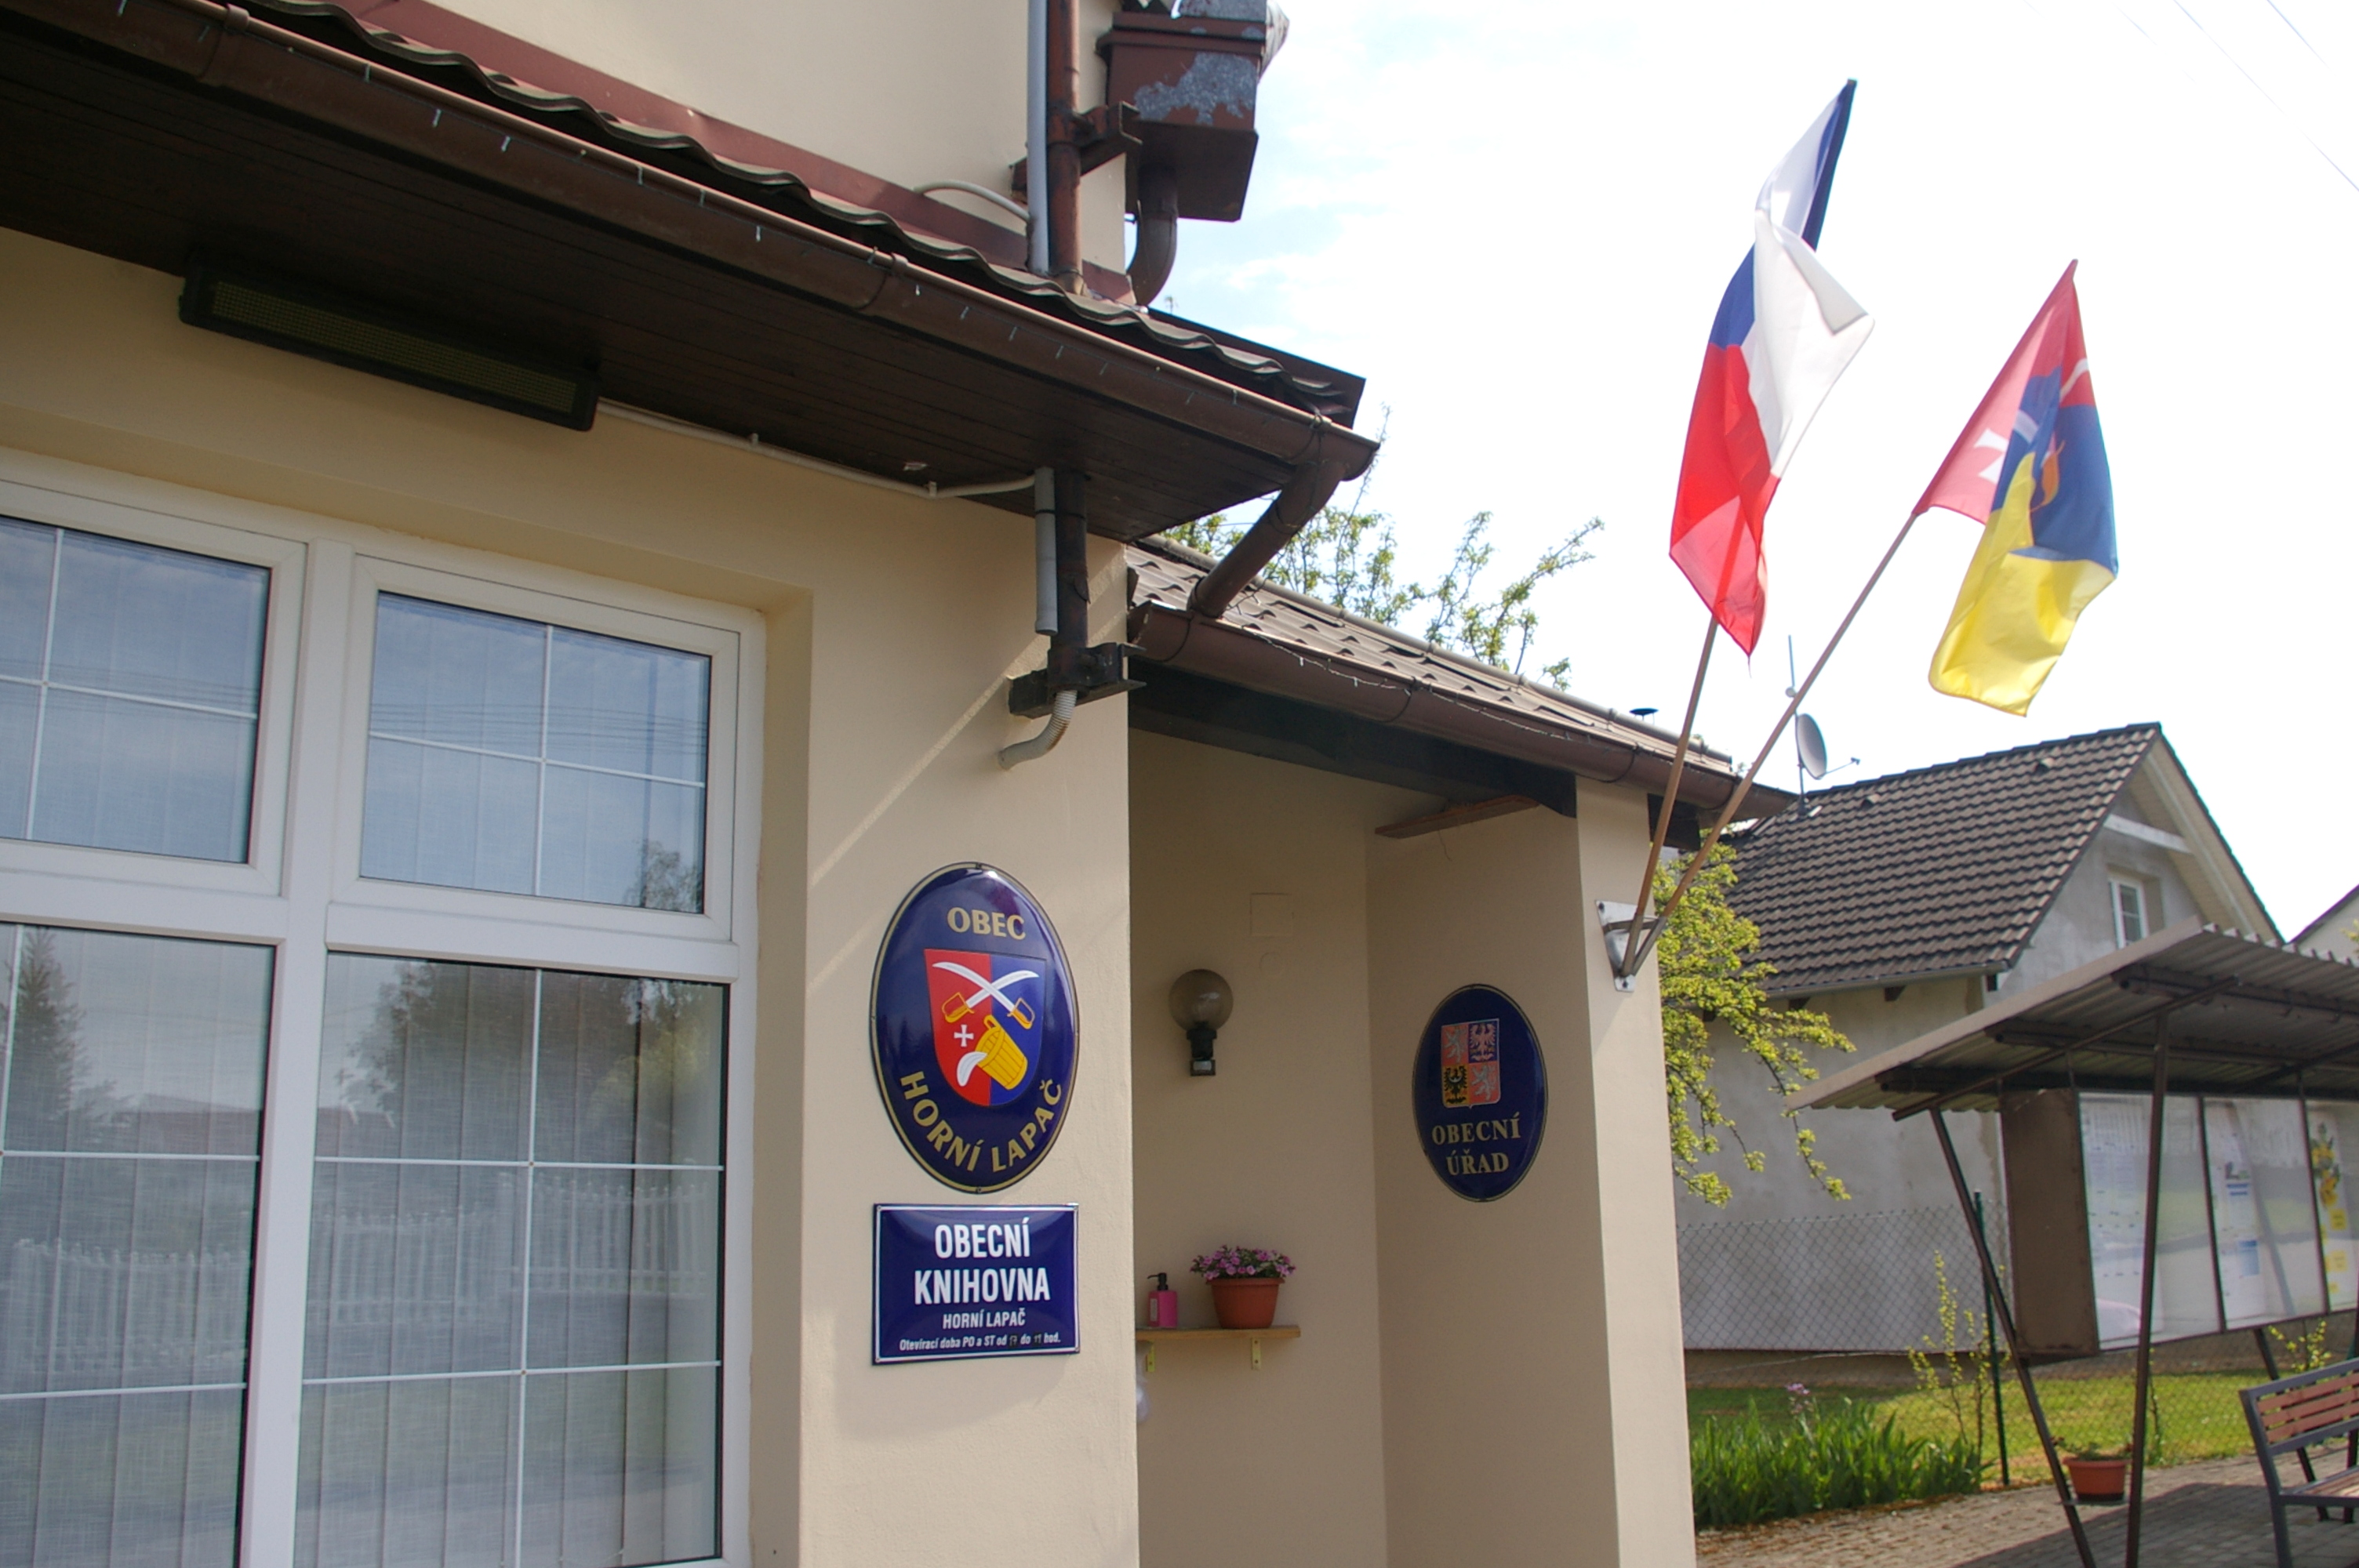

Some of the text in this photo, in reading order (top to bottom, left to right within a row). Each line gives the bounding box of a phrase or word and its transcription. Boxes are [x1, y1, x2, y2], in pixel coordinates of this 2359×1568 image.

[947, 907, 1027, 940] OBEC
[900, 1071, 1062, 1173] HORNÍ LAPAČ
[1431, 1112, 1521, 1145] OBECNÍ
[1445, 1149, 1509, 1176] ÚŘAD
[934, 1217, 1030, 1258] OBECNÍ
[914, 1267, 1051, 1305] KNIHOVNA
[943, 1307, 1026, 1329] HORNÍ LAPAČ
[940, 1337, 961, 1349] doba
[962, 1335, 975, 1348] PO
[976, 1338, 982, 1347] a
[983, 1334, 996, 1346] ST
[996, 1334, 1007, 1346] od
[1020, 1334, 1031, 1345] do
